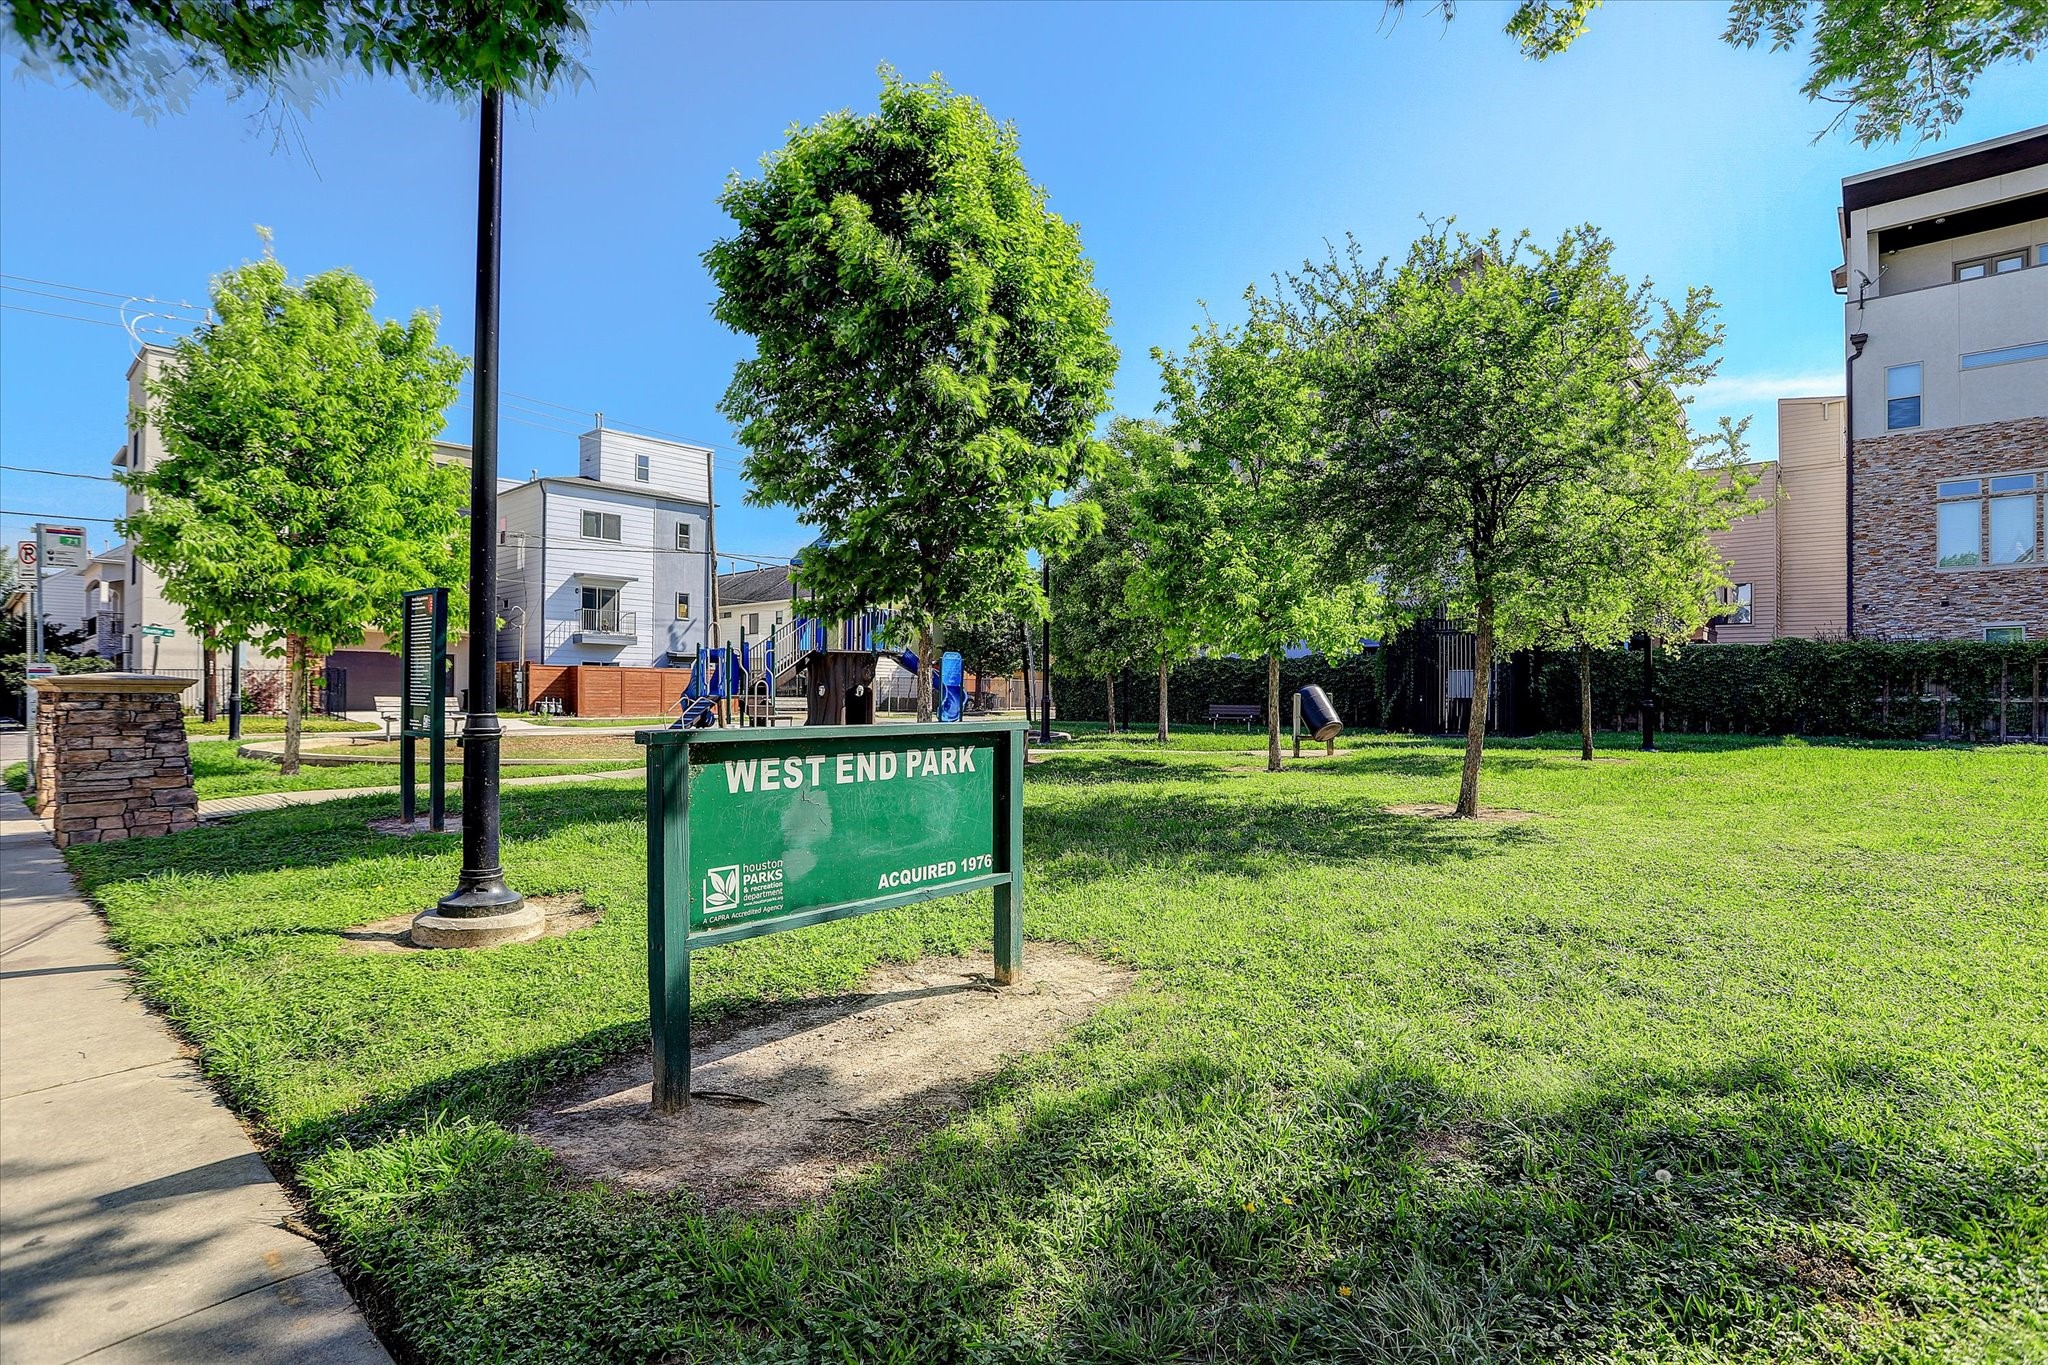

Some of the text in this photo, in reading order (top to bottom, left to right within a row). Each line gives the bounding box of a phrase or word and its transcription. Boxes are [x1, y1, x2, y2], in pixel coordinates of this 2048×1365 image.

[725, 745, 976, 794] WEST END PARK
[742, 860, 784, 873] houston
[877, 854, 993, 890] ACQUIRED 1976
[743, 869, 783, 886] PARKS
[743, 888, 783, 901] department
[750, 881, 783, 892] recreation
[709, 914, 730, 923] CAPRA
[731, 907, 762, 919] Accredited
[763, 904, 784, 913] Agency
